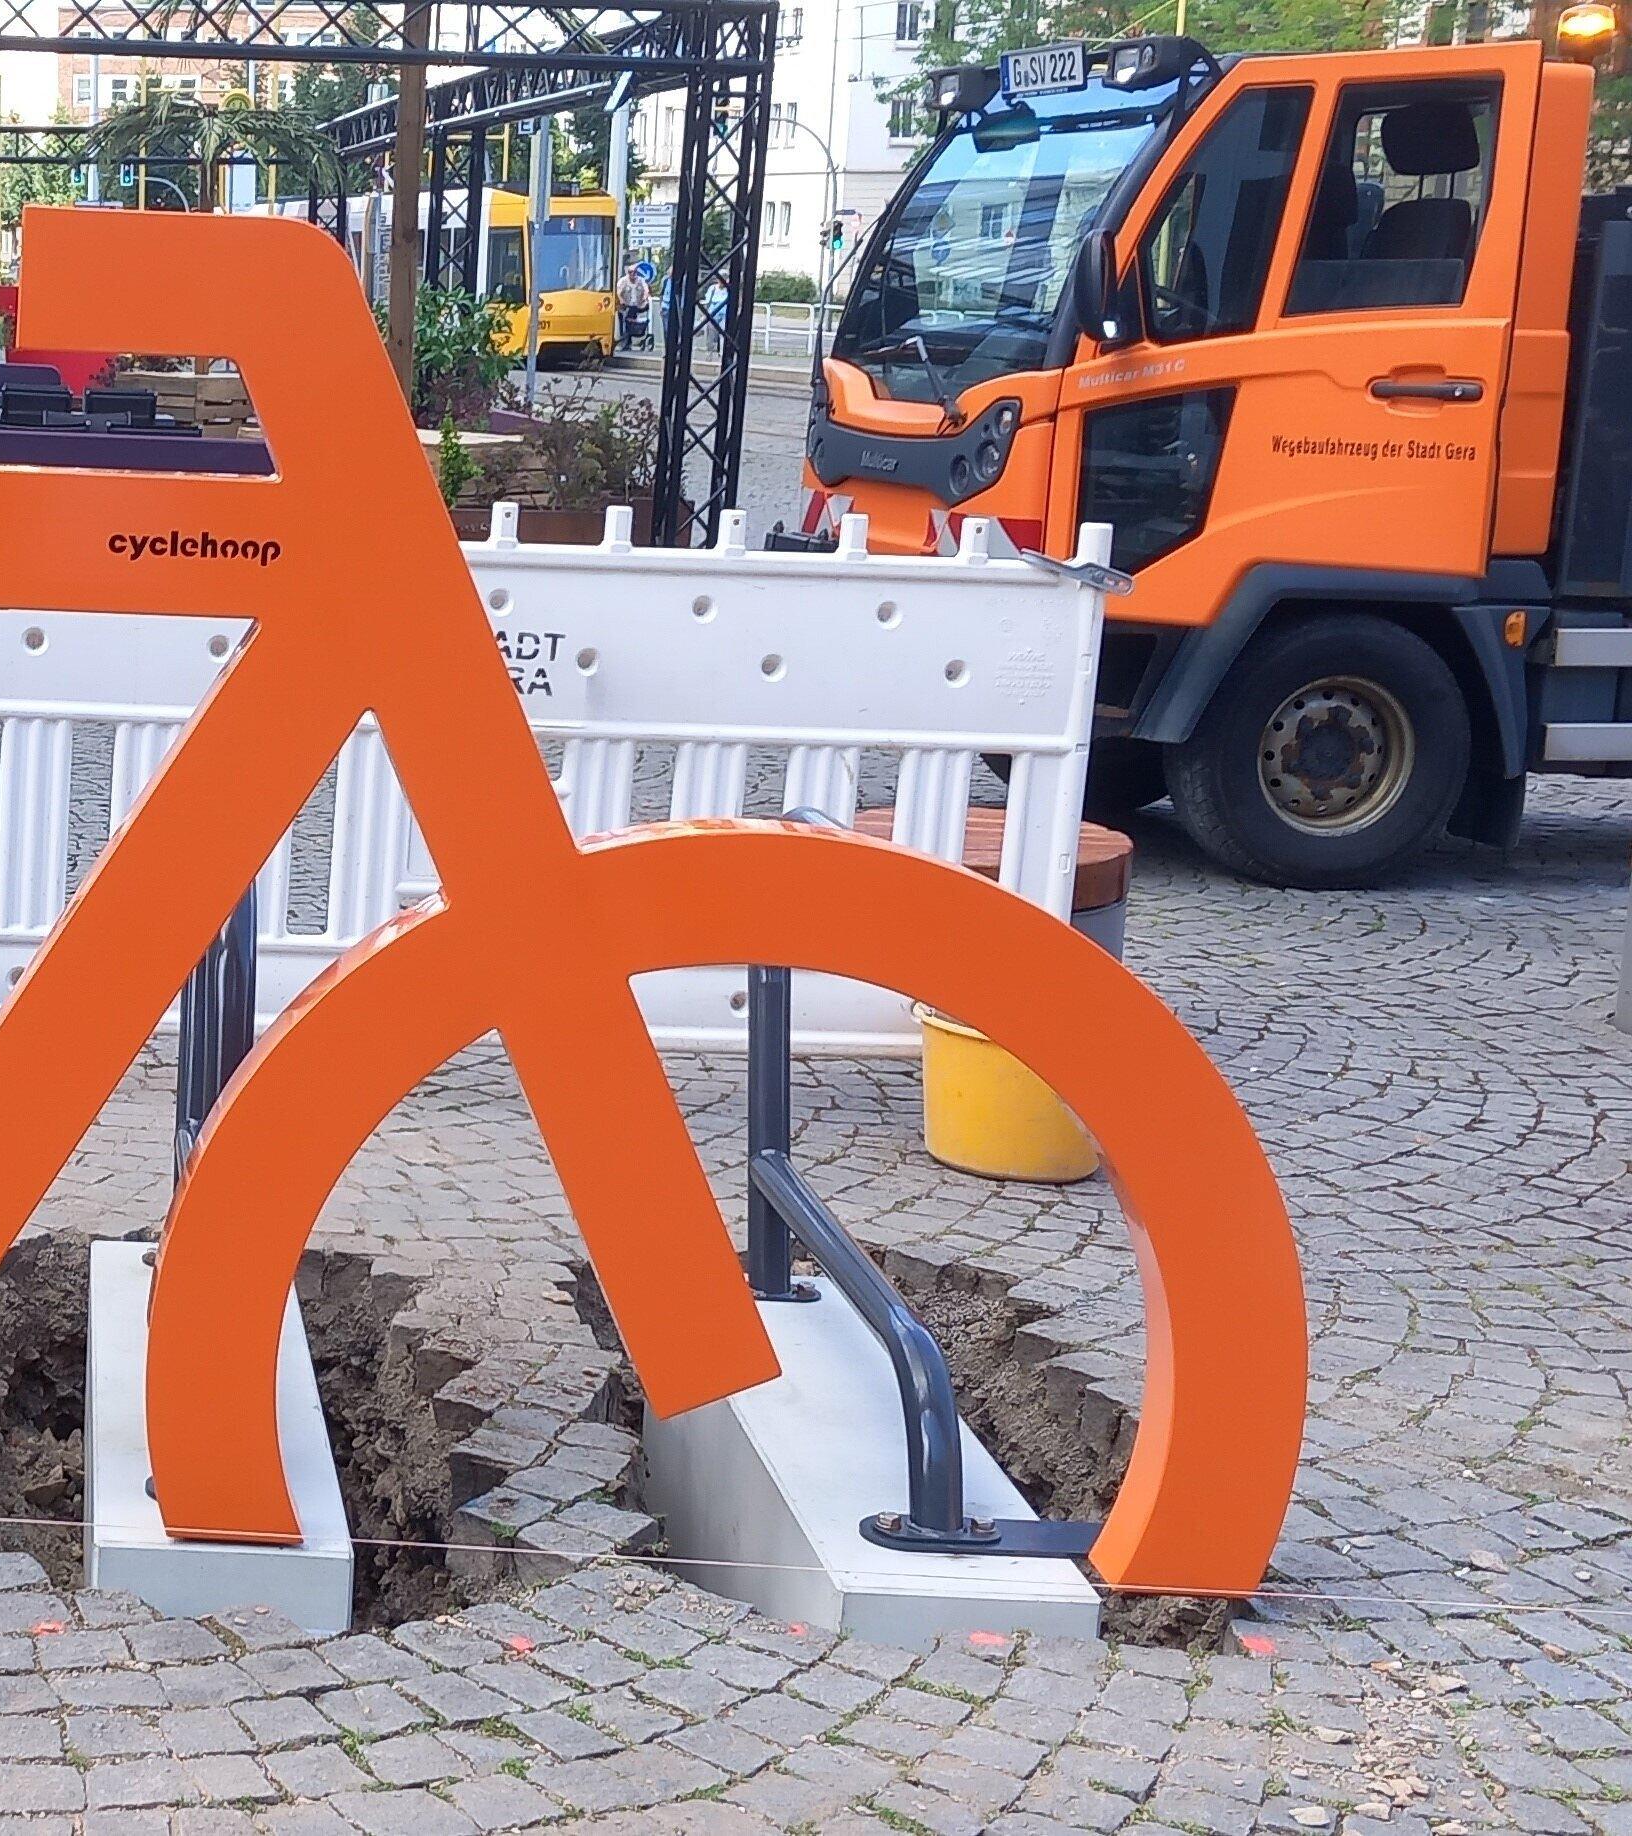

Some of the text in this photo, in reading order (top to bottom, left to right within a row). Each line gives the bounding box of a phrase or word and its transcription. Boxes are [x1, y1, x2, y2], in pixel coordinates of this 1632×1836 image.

[1013, 50, 1077, 87] G SV 222
[1077, 368, 1140, 389] Multicar
[1271, 434, 1477, 461] Wegebaufahrzeug der Stadt Gera
[108, 530, 281, 567] cyclehoop
[494, 630, 566, 662] ADT
